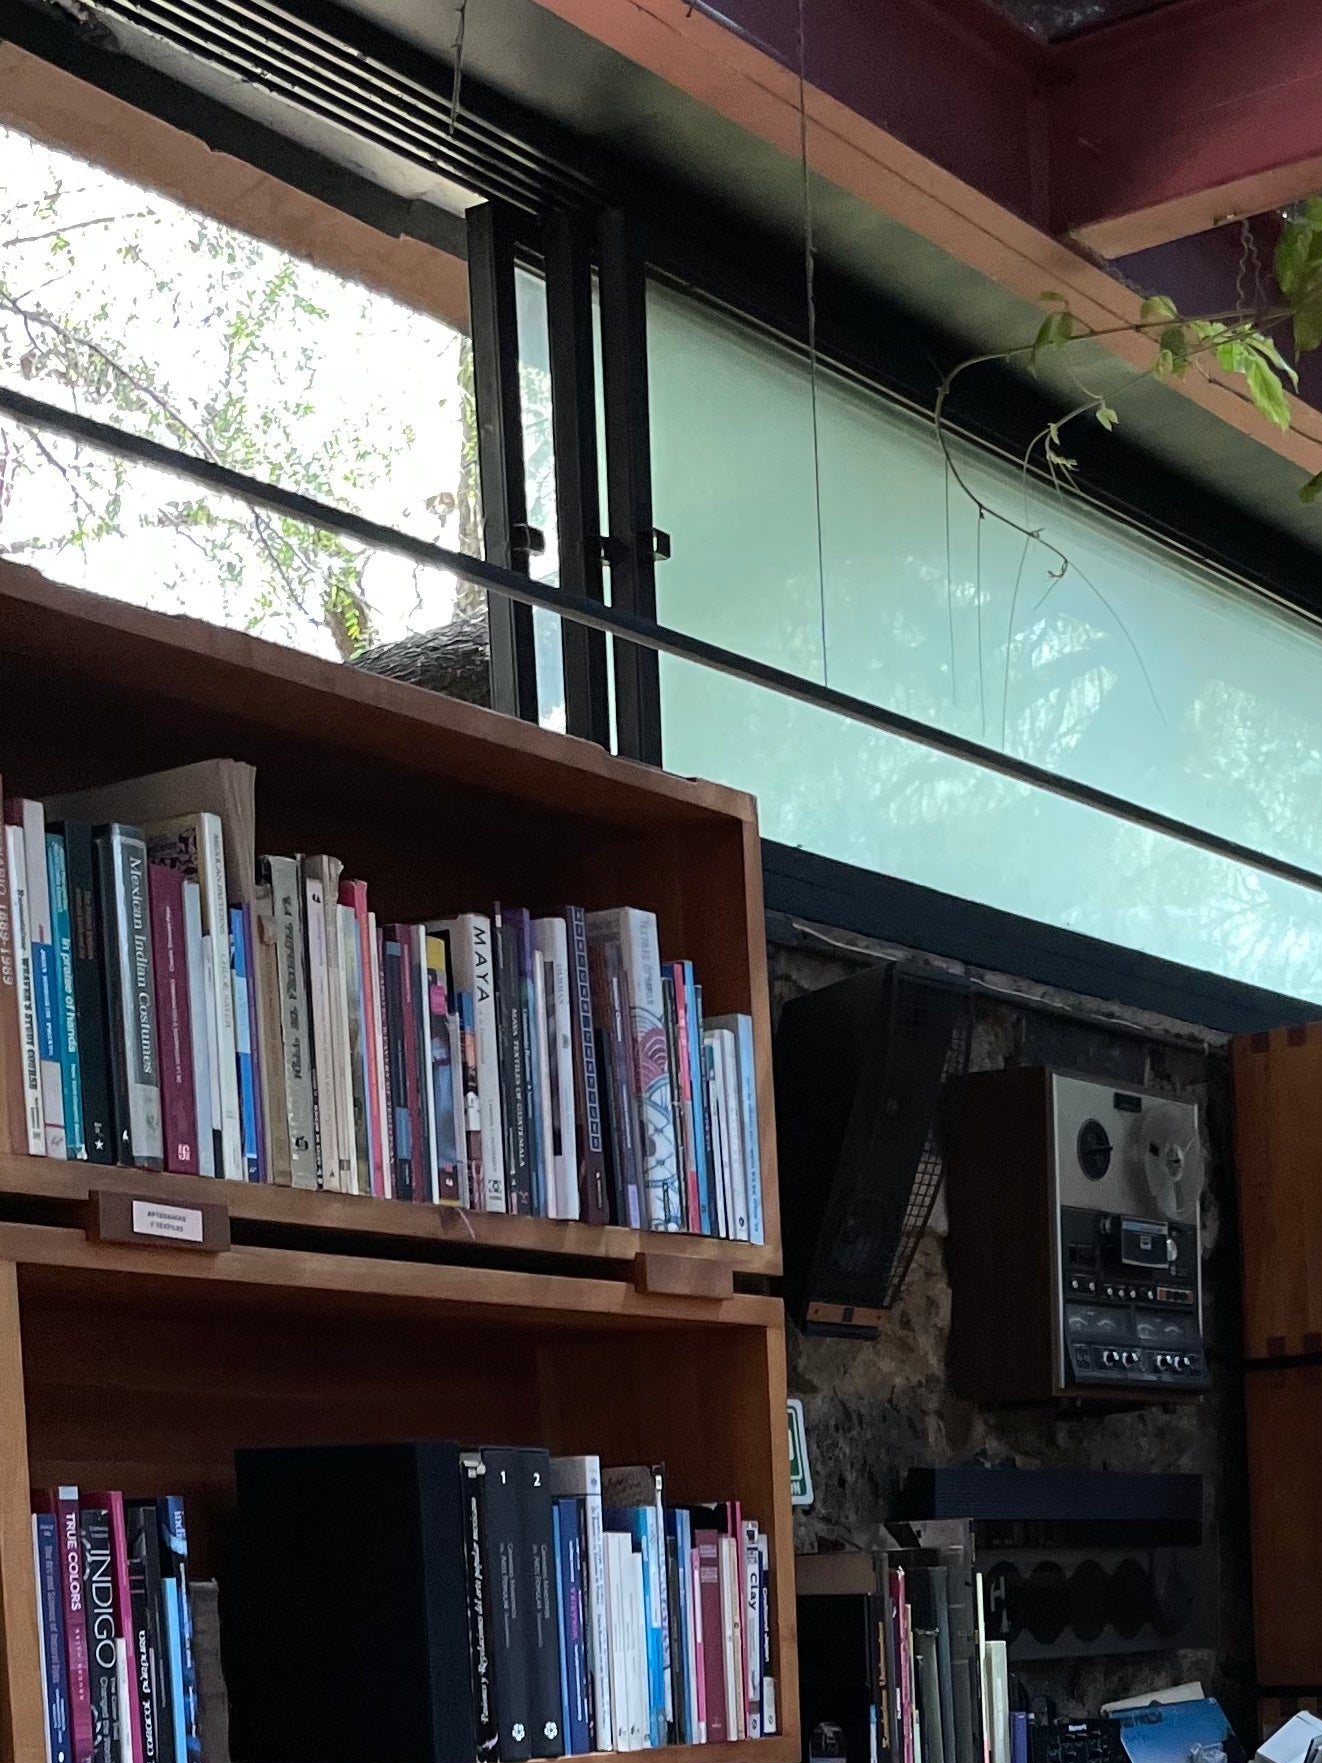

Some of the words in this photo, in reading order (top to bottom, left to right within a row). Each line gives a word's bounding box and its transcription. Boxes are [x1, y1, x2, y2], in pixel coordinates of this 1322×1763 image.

[128, 855, 145, 929] Mexican
[20, 957, 33, 1010] WEAVER'S
[61, 952, 72, 993] praise
[133, 934, 148, 986] Indian
[473, 926, 490, 1002] MAYA
[24, 1013, 35, 1046] STUDY
[137, 992, 153, 1073] Costumes
[500, 1471, 507, 1484] 1
[533, 1473, 541, 1486] 2
[64, 1511, 77, 1549] TRUE
[66, 1551, 81, 1611] COLORS
[748, 1571, 759, 1611] Clay
[86, 1546, 117, 1669] INDIGO
[143, 1699, 155, 1756] caracol
